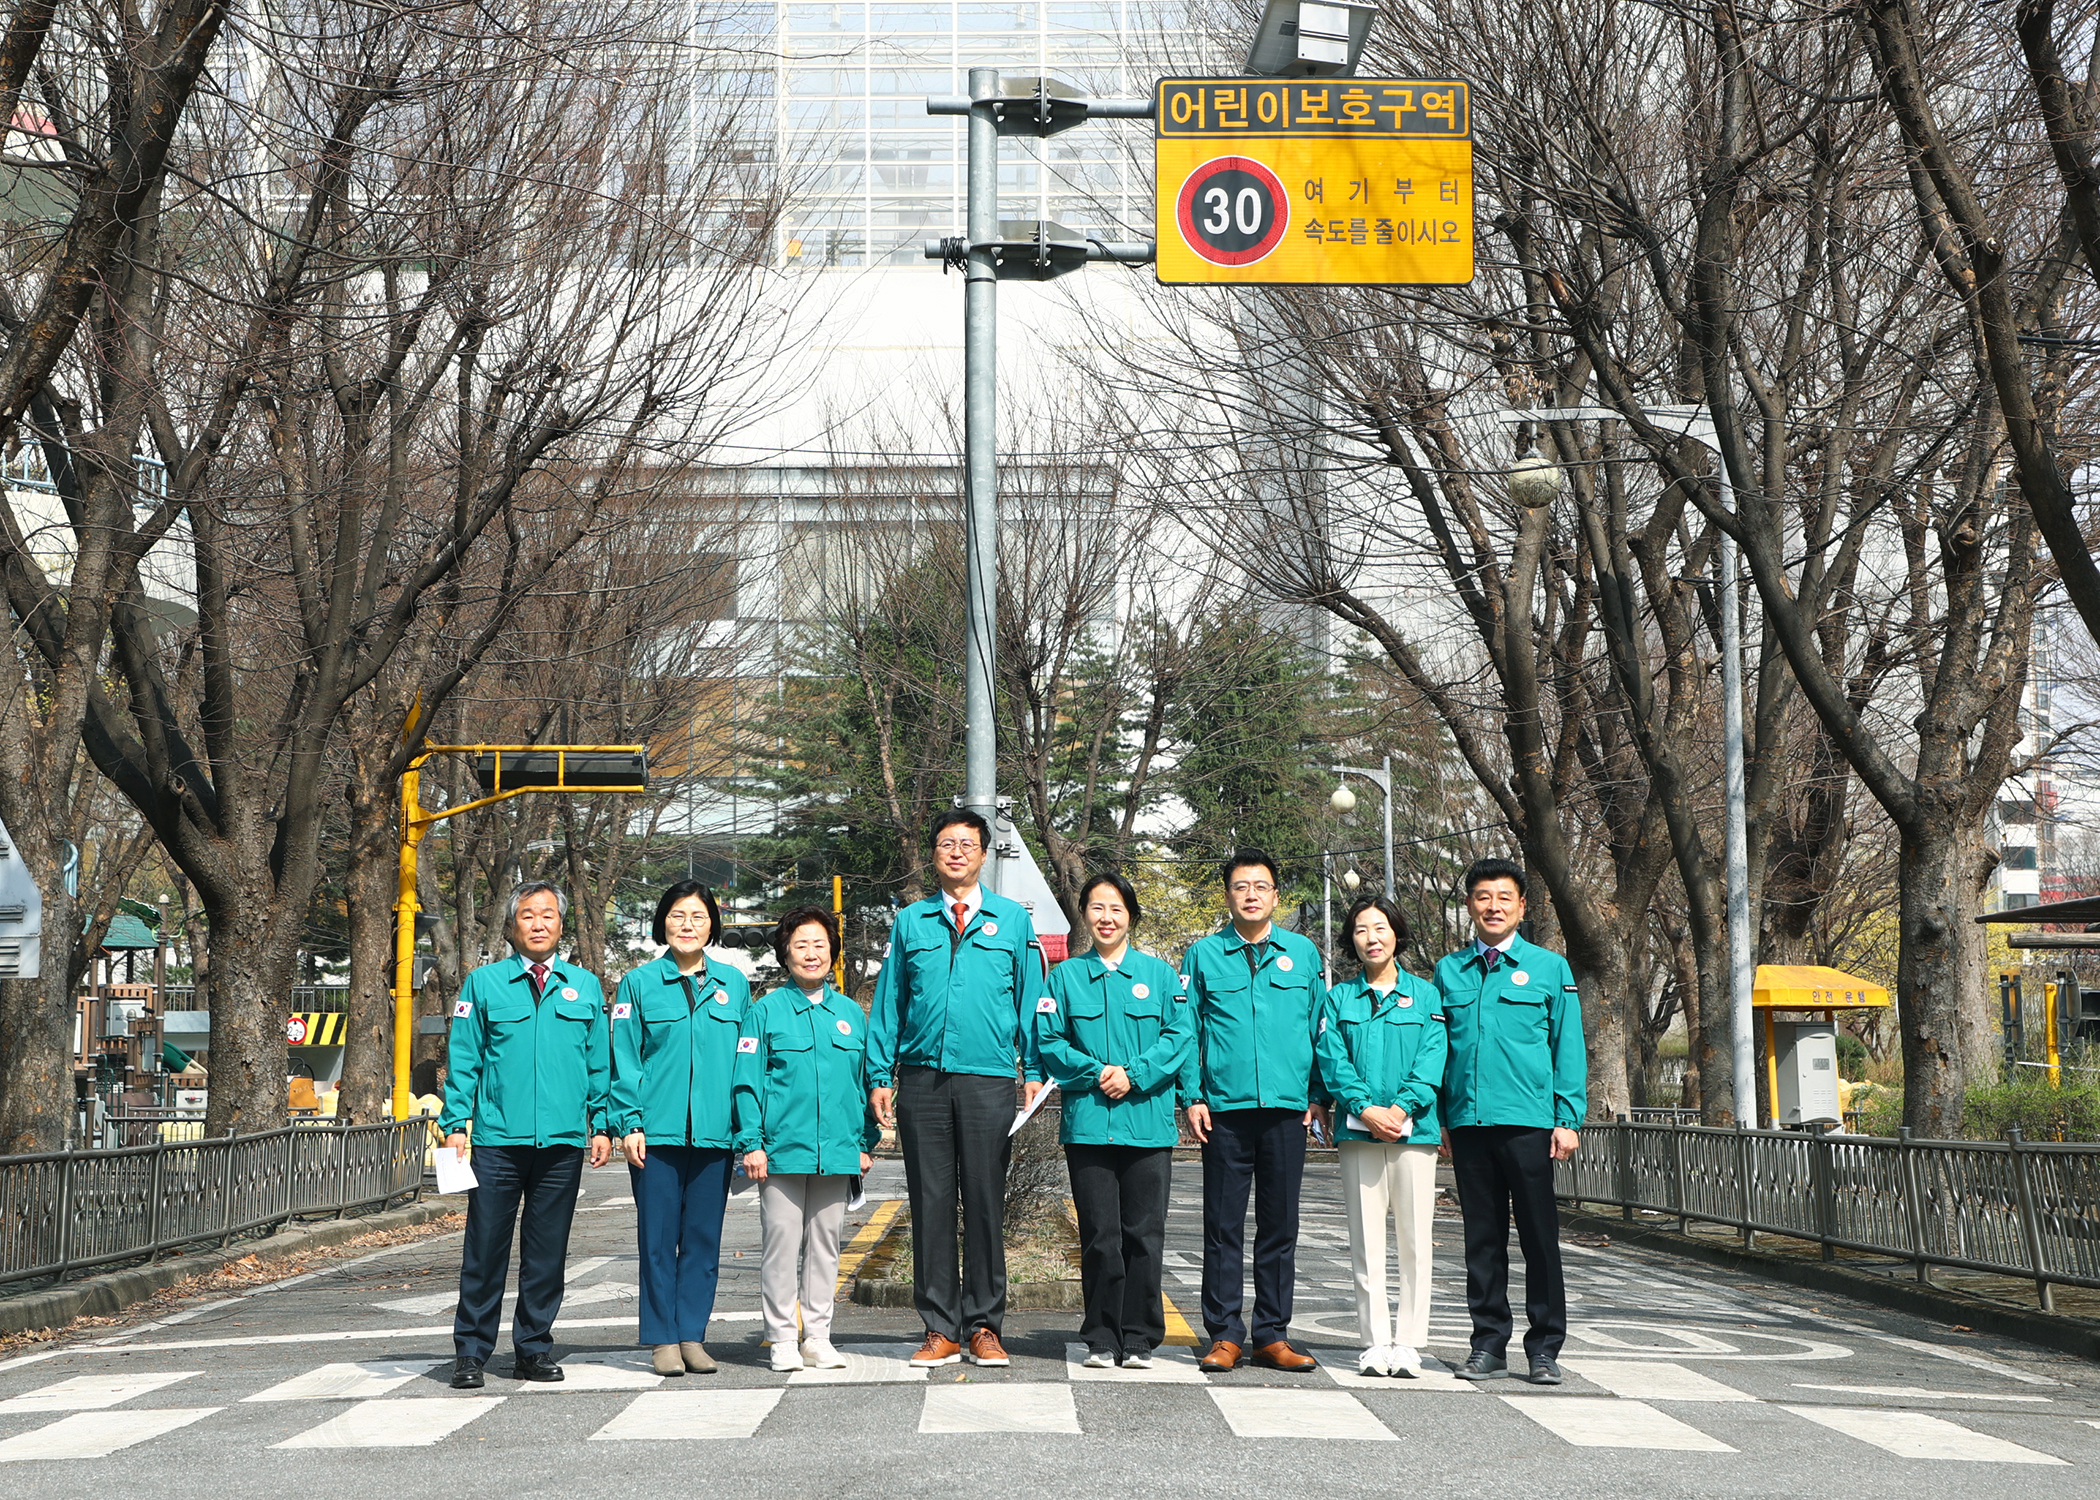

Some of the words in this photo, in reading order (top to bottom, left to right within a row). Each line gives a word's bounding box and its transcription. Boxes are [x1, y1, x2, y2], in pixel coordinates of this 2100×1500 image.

[1170, 87, 1455, 129] 어린이보호구역
[1203, 187, 1262, 235] 30
[1304, 218, 1369, 245] 속도를
[1374, 218, 1461, 245] 줄이시오
